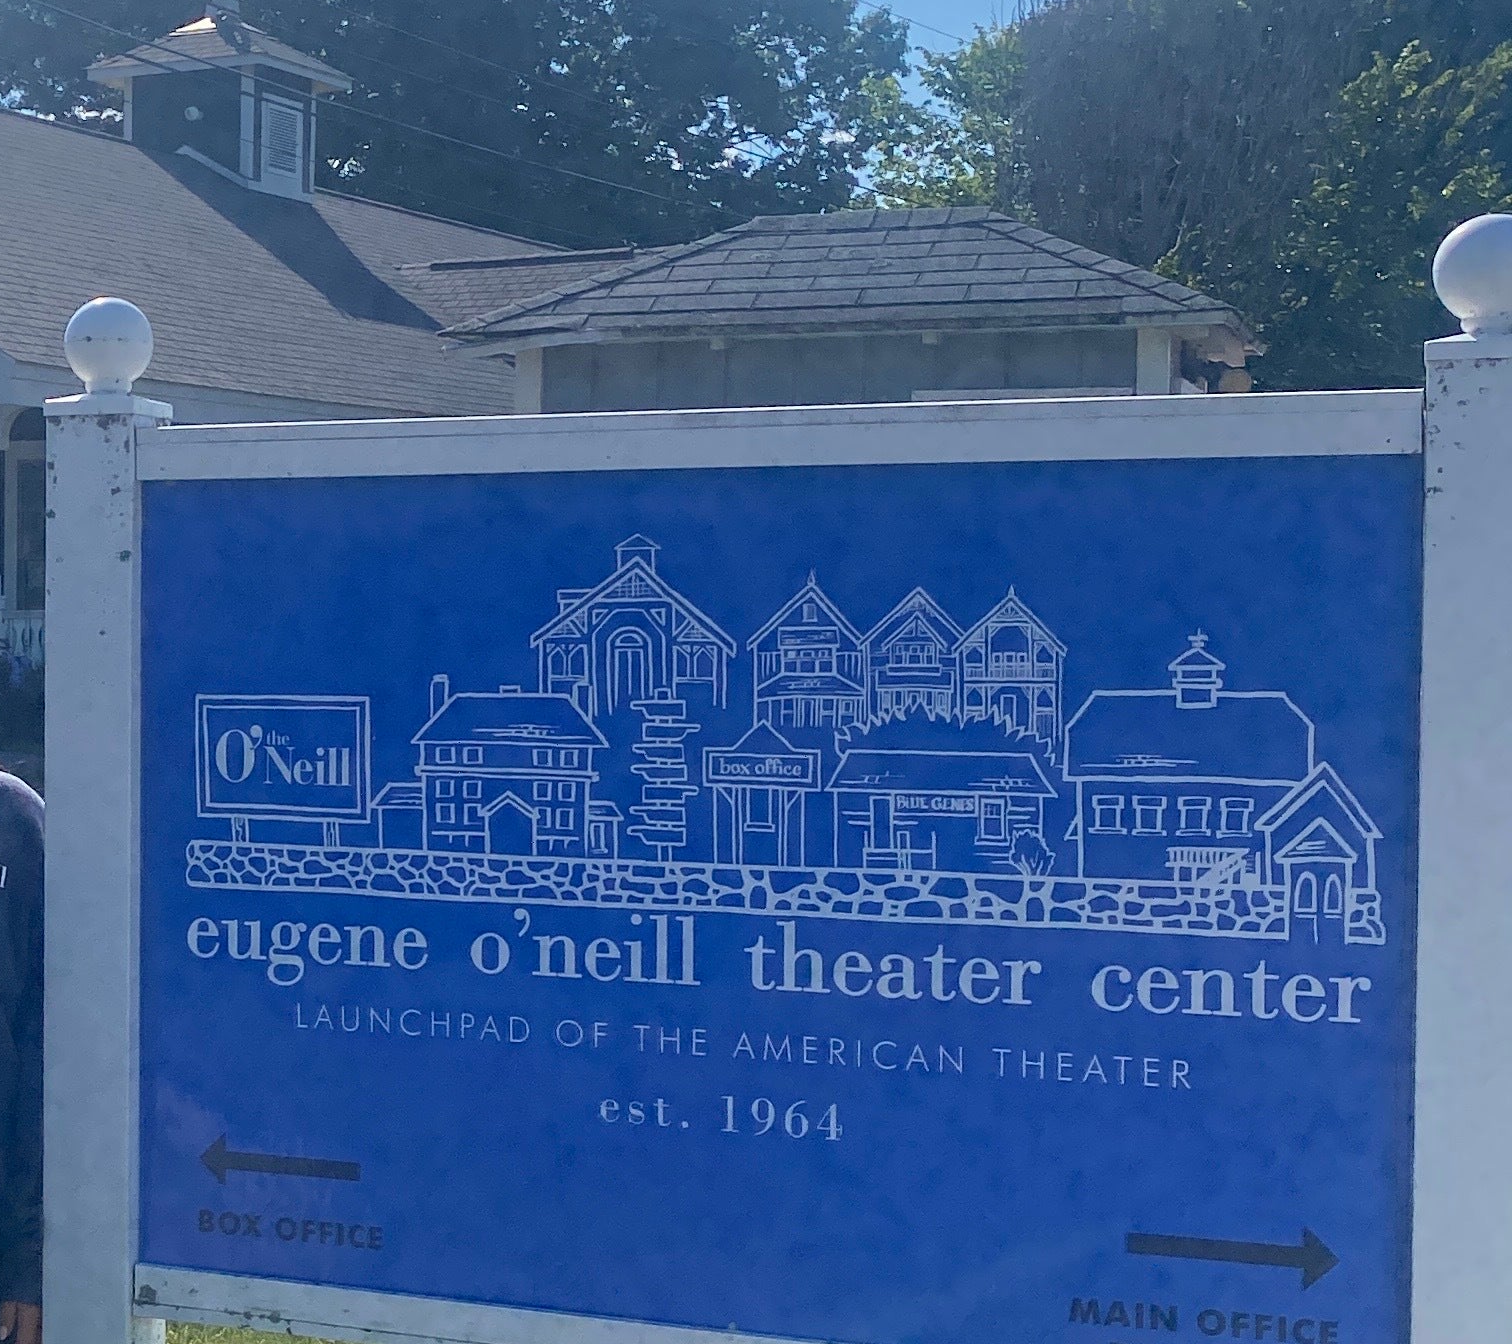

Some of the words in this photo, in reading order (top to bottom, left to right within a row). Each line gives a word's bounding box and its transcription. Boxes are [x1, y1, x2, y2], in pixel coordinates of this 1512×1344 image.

[215, 724, 351, 786] O'Neill
[719, 758, 750, 774] box
[754, 758, 802, 776] office
[187, 915, 428, 986] eugene
[470, 907, 700, 986] o'neill
[745, 920, 1042, 1006] theater
[1091, 958, 1371, 1024] center
[296, 1002, 530, 1044] LAUNCHPAD
[556, 1018, 608, 1049] OF
[635, 1024, 708, 1057] THE
[733, 1033, 963, 1073] AMERICAN
[993, 1046, 1192, 1089] THEATER
[599, 1097, 690, 1130] est.
[719, 1094, 843, 1142] 1964
[197, 1209, 262, 1240] BOX
[274, 1215, 383, 1251] OFFICE
[1068, 1297, 1178, 1331] MAIN
